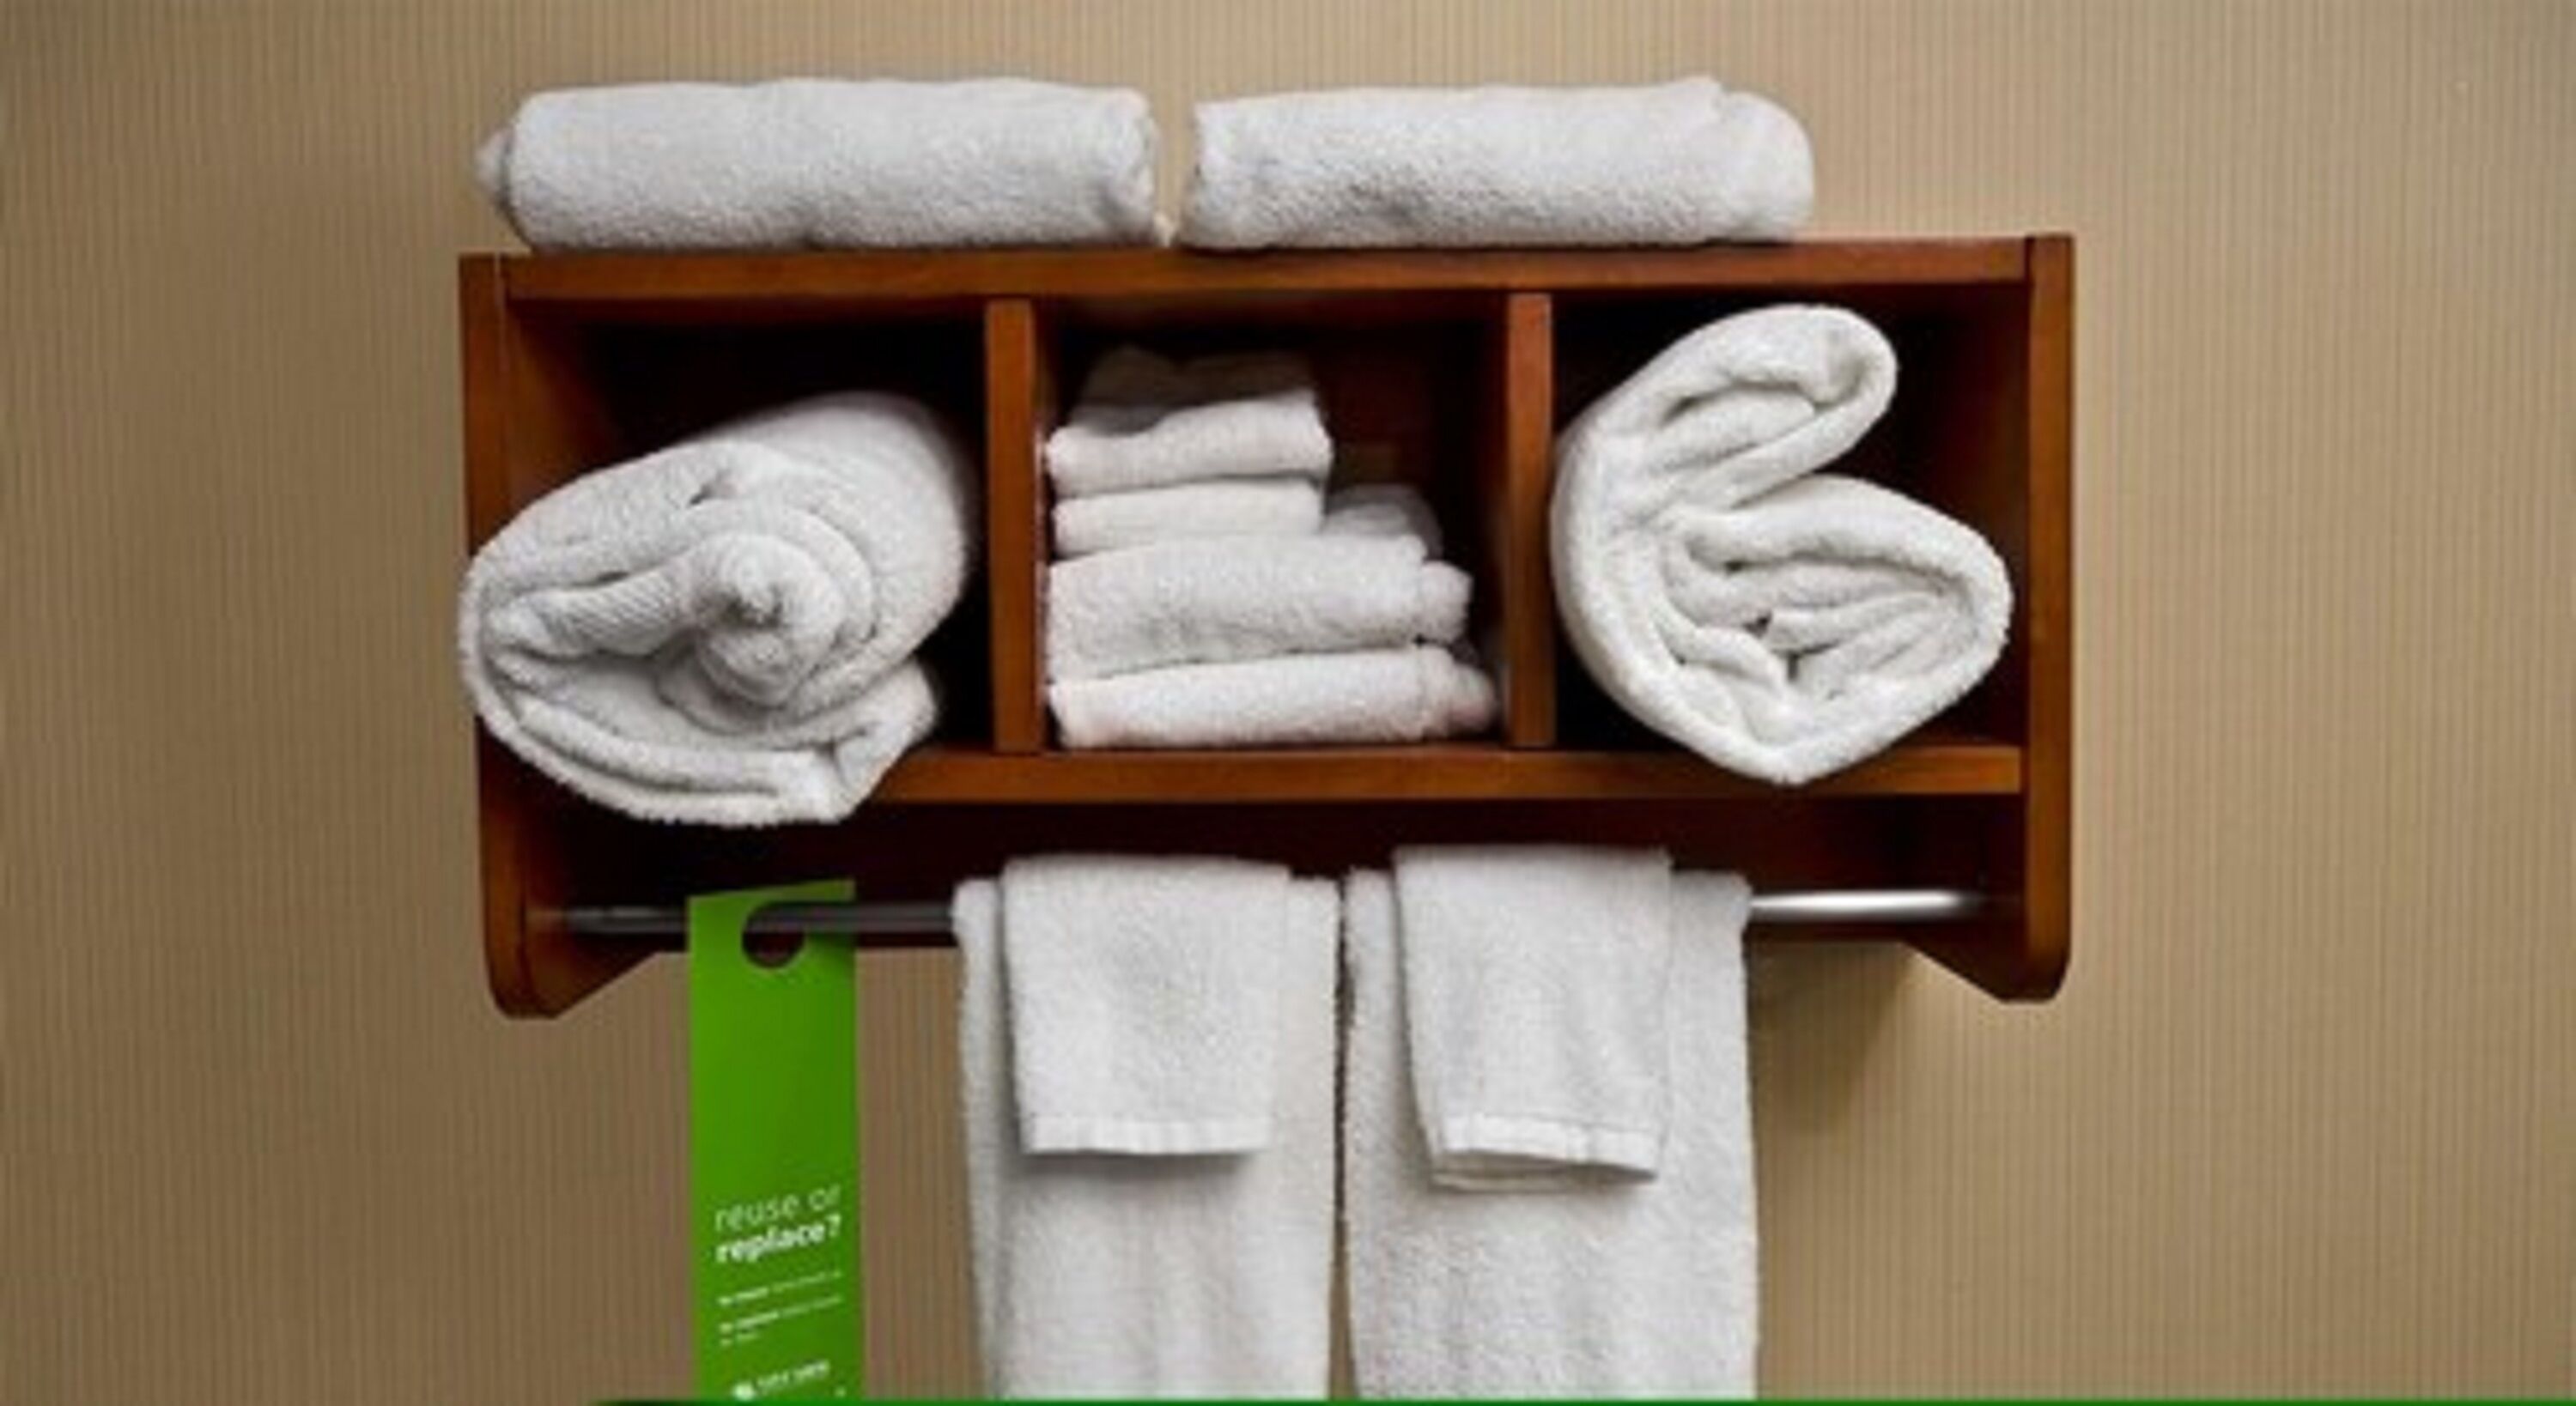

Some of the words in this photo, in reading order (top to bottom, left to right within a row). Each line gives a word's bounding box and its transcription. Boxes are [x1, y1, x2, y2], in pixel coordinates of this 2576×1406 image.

[714, 1194, 799, 1231] reuse
[808, 1185, 841, 1211] or
[714, 1214, 841, 1263] replace?
